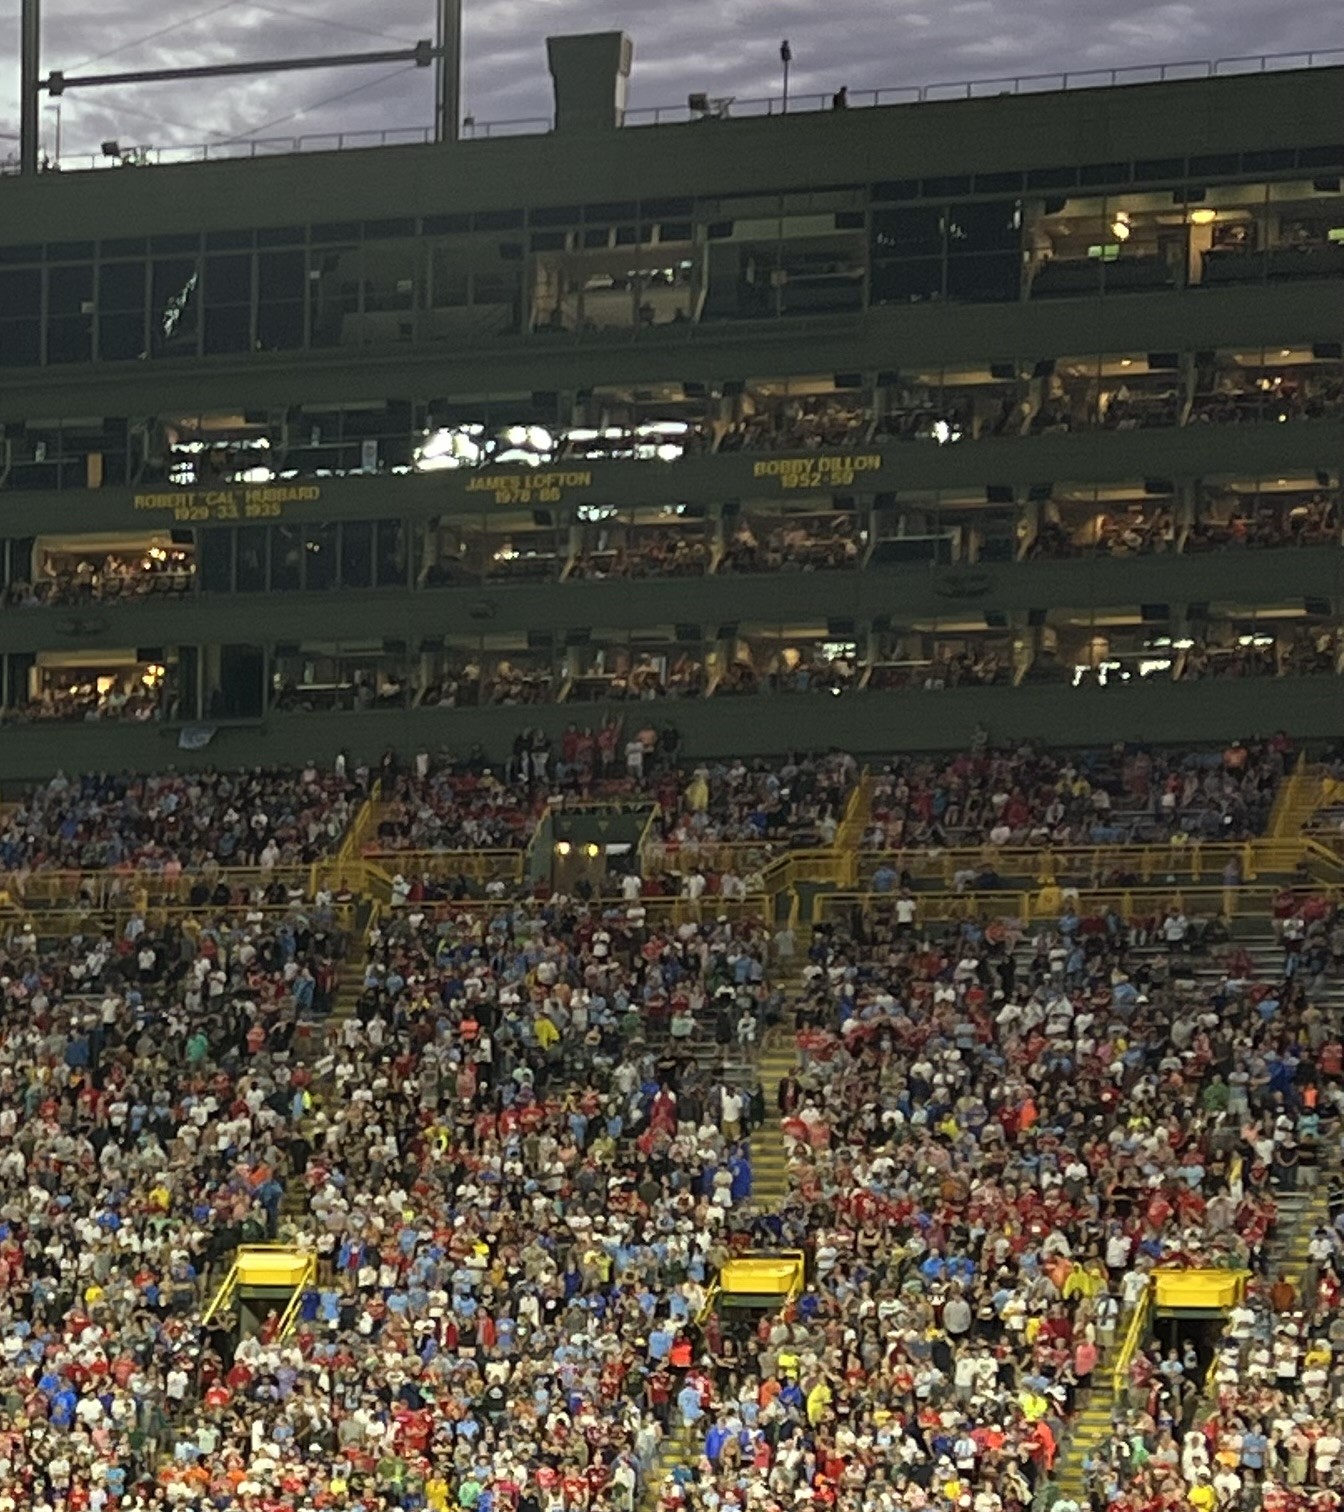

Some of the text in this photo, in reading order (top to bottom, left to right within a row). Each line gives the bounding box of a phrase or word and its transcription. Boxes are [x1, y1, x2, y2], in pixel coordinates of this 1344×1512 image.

[754, 455, 881, 477] BOBBY DILLON
[465, 471, 591, 491] JAMES LOFTON
[134, 493, 195, 510] ROBERT
[245, 486, 320, 502] HUBBARD
